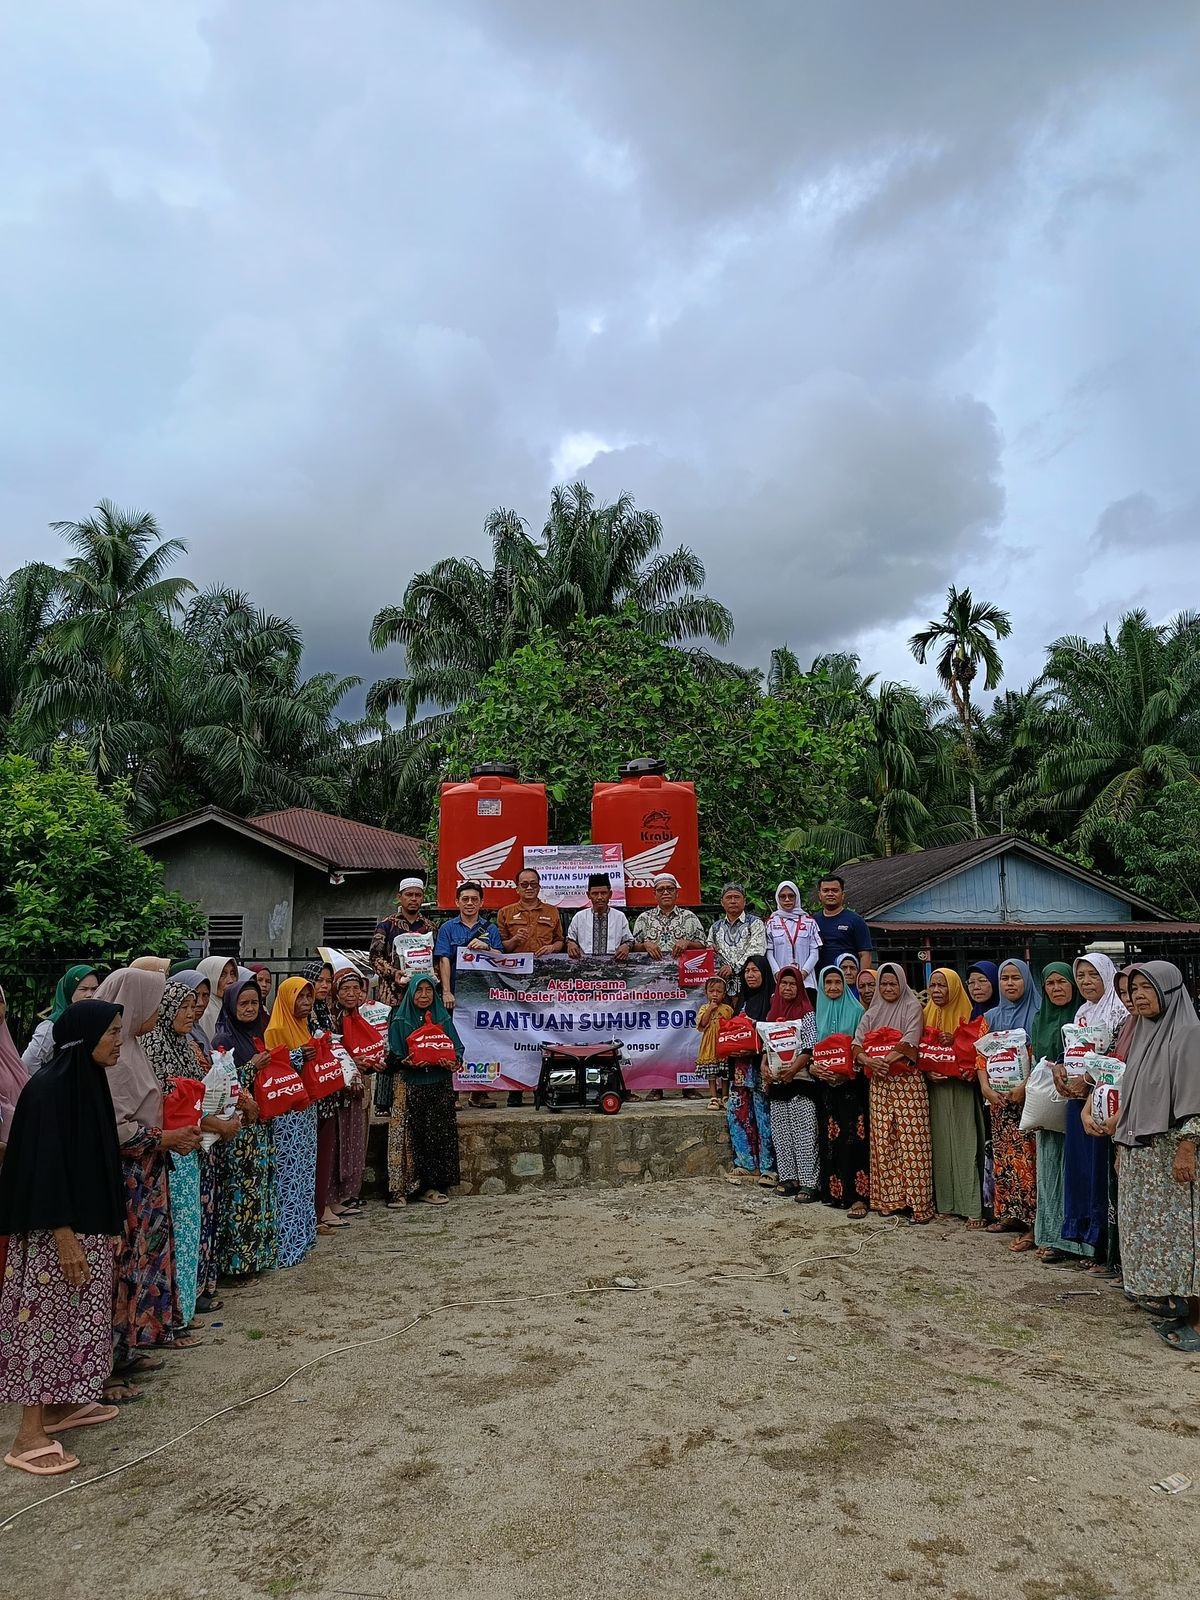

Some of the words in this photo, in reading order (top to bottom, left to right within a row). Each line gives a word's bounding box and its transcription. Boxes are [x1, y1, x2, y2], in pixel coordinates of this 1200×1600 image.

[547, 979, 573, 990] Aksi
[575, 980, 626, 990] Bersama
[490, 988, 515, 1000] Main
[518, 991, 555, 1002] Dealer
[557, 991, 591, 1002] Motor
[594, 992, 630, 1001] Honda
[632, 988, 687, 1000] Indonesia
[475, 1010, 573, 1032] BANTUAN
[578, 1011, 652, 1031] SUMUR
[656, 1009, 697, 1029] BOR
[514, 1042, 543, 1051] Untuk
[626, 1042, 660, 1052] ongsor
[815, 1048, 845, 1057] HONDA
[274, 1072, 300, 1085] HONDA
